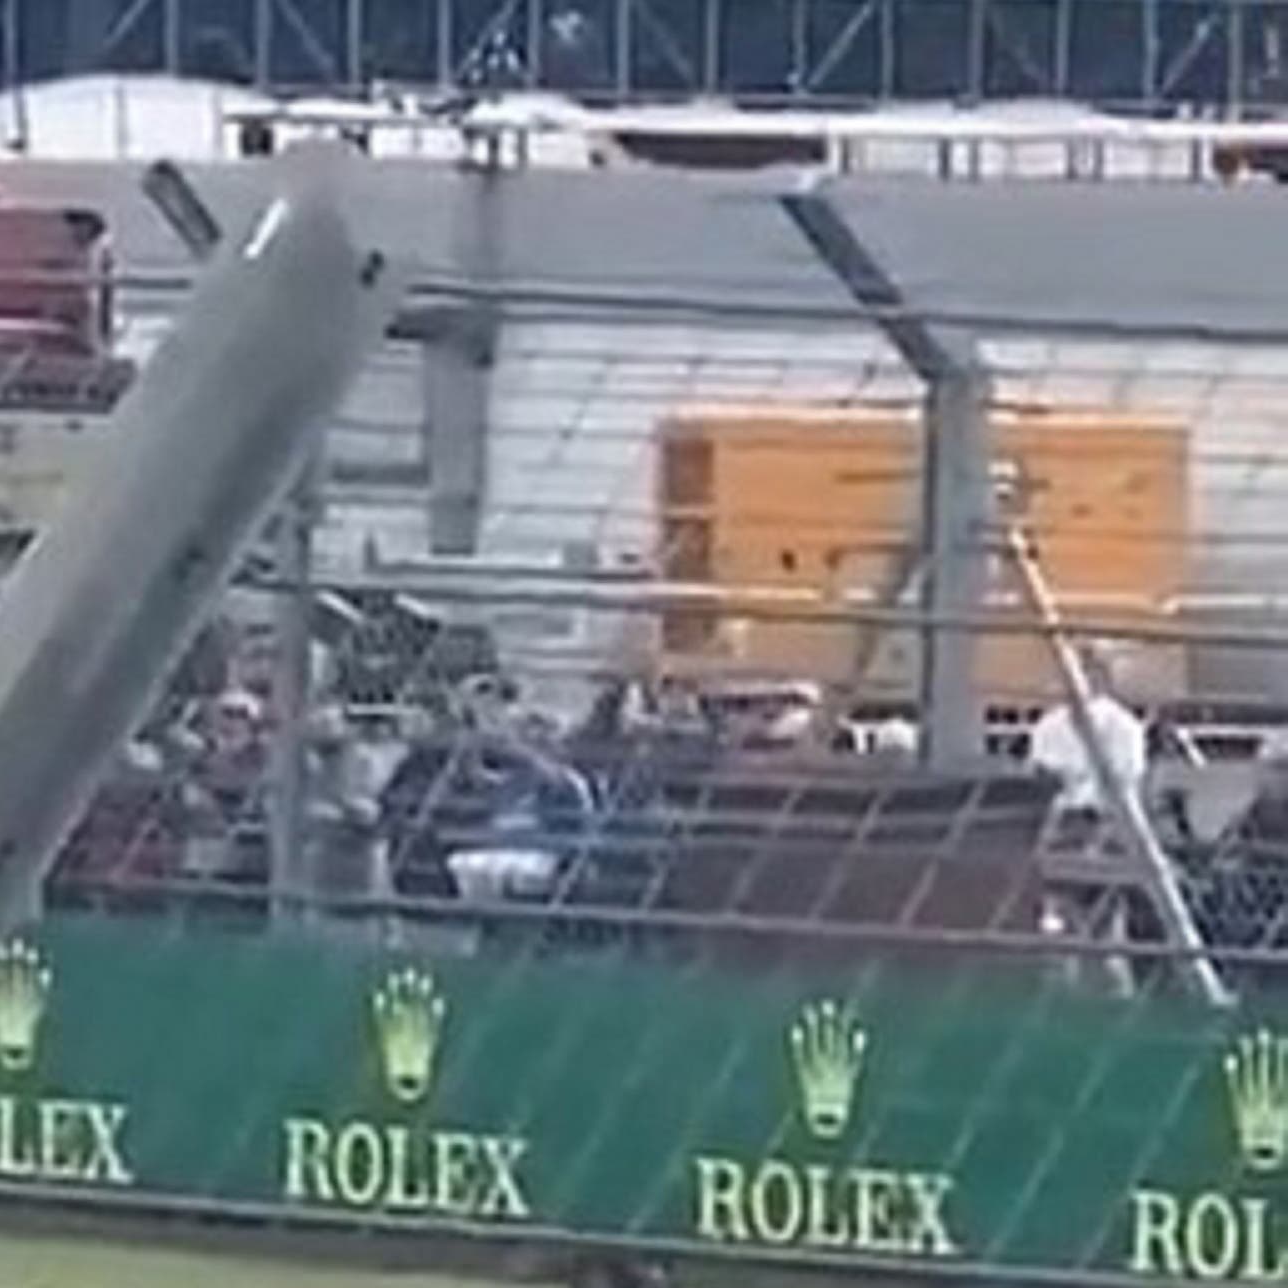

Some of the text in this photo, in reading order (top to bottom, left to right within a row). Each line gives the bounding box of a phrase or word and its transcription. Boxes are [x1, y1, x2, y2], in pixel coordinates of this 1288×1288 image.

[285, 1118, 531, 1215] ROLEX
[695, 1158, 958, 1255] ROLEX
[1129, 1187, 1288, 1281] ROL
